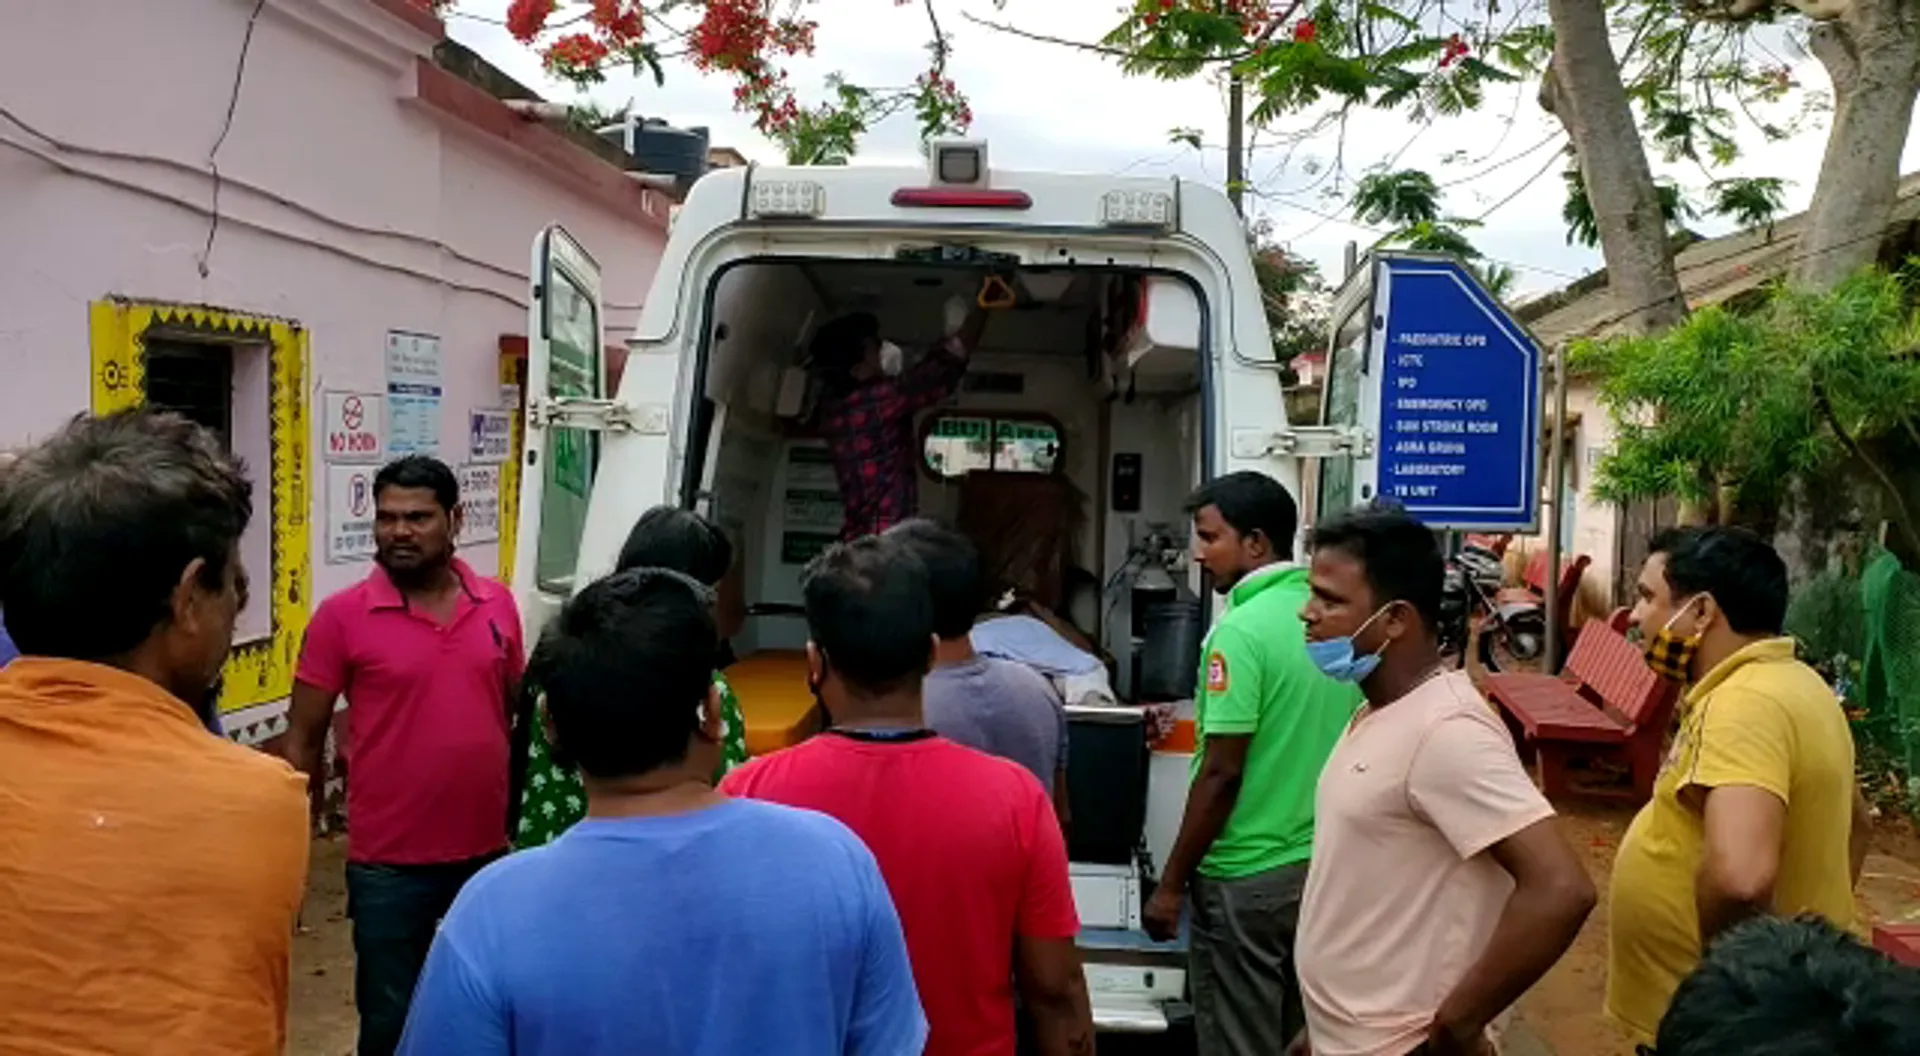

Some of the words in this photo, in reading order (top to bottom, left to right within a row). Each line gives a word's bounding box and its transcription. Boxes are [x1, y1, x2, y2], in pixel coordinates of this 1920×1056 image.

[1399, 333, 1461, 347] PAEDIATRIC
[1464, 334, 1487, 347] OPD
[1397, 377, 1417, 389] IPD
[1397, 399, 1463, 410] EMERGENCY
[1465, 399, 1488, 412] OPD
[1422, 420, 1465, 433] STROKE
[1467, 421, 1498, 433] ROOM
[330, 432, 346, 451] NO
[348, 432, 377, 451] HORN
[1394, 464, 1465, 475] LABORATORY
[1394, 485, 1408, 497] TB
[1410, 485, 1438, 497] UNIT
